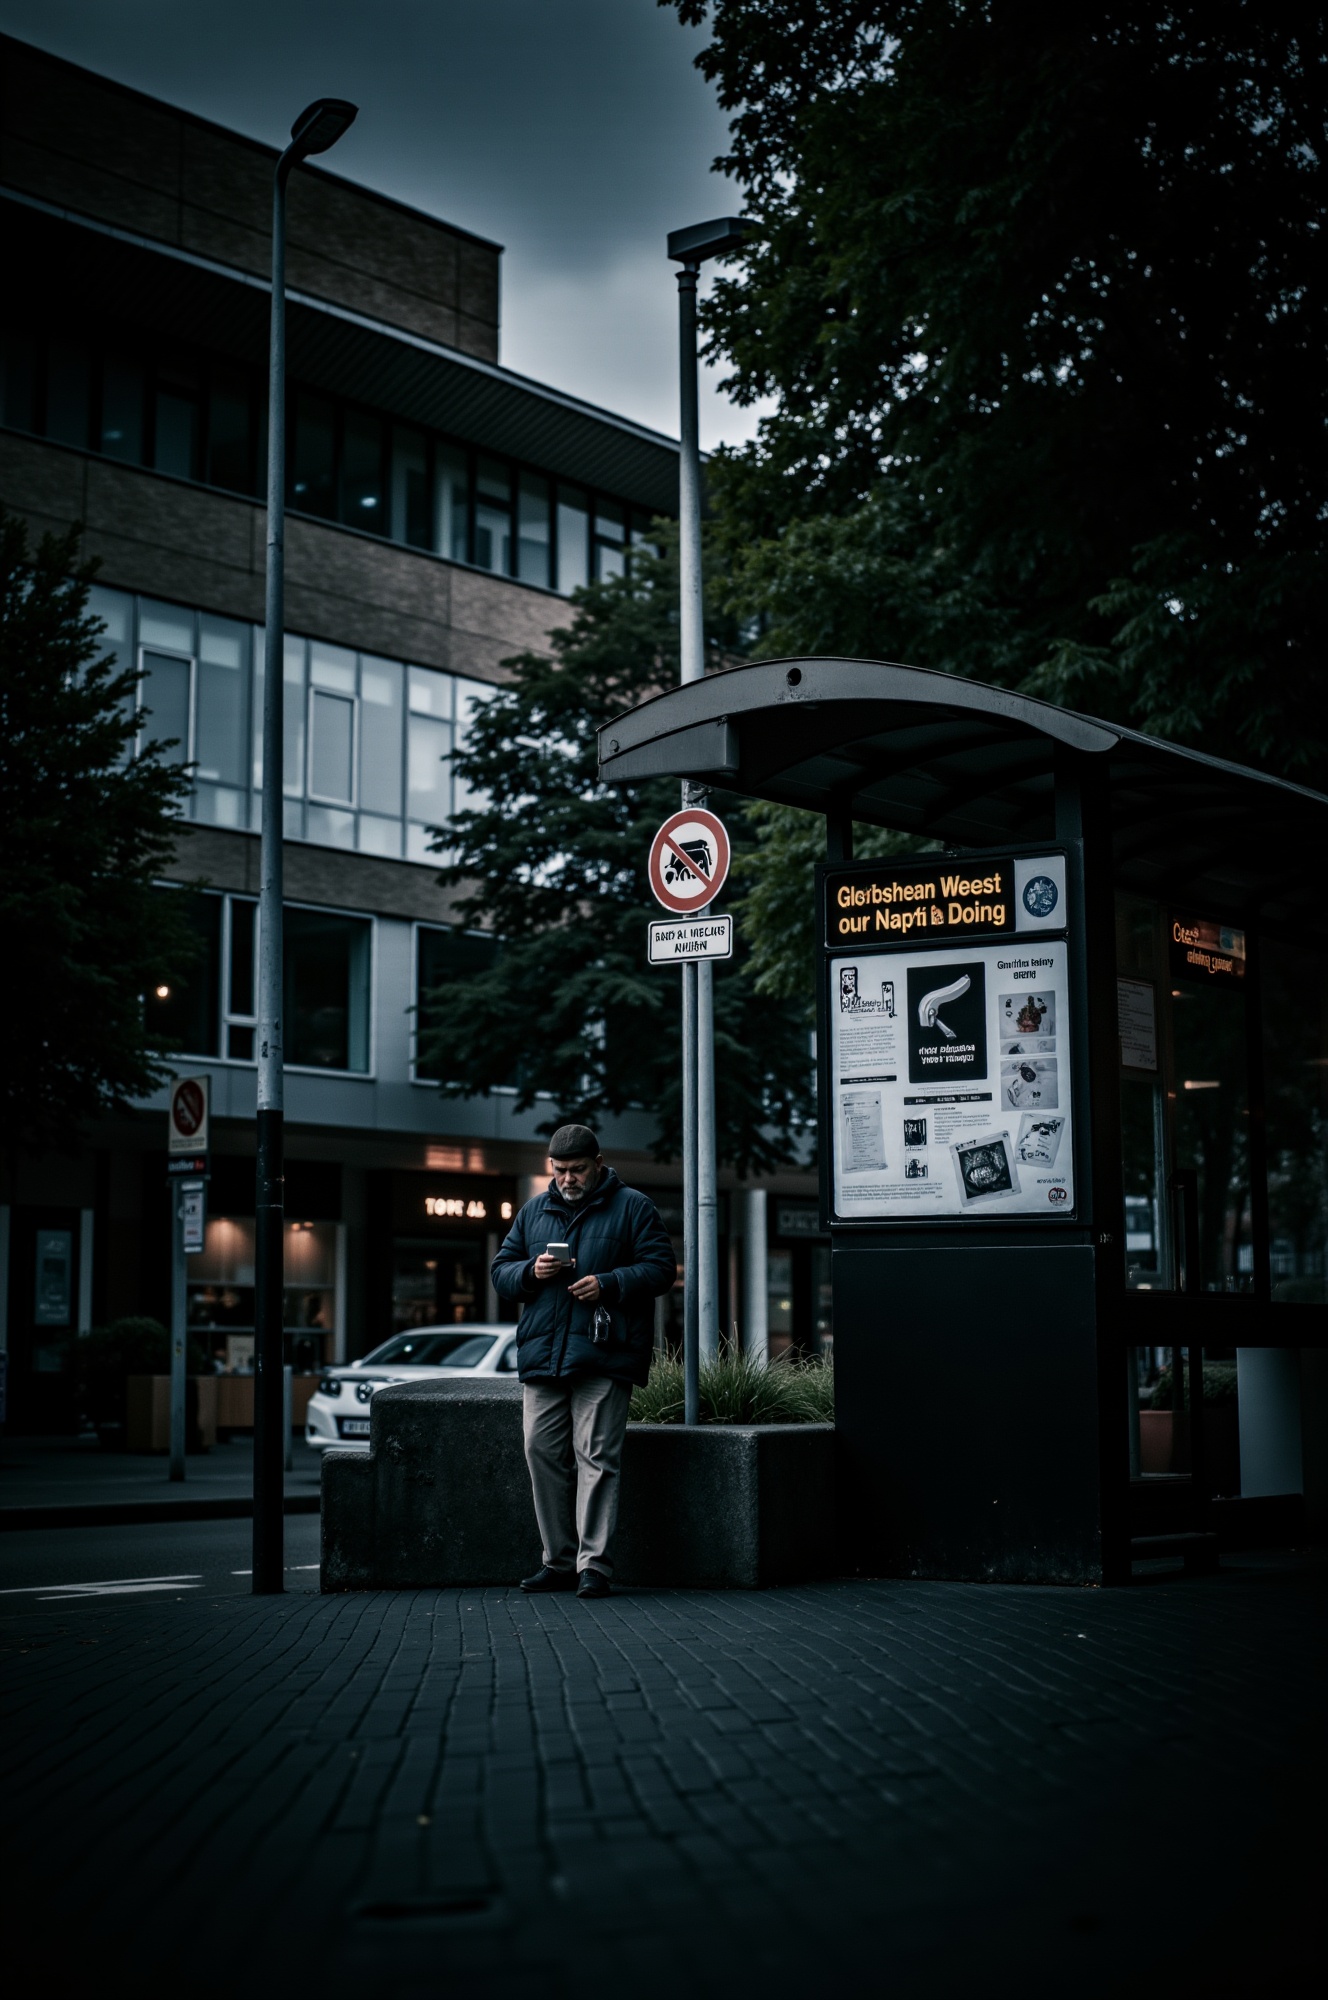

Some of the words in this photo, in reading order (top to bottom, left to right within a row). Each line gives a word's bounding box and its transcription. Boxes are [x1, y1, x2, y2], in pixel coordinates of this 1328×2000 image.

[940, 873, 1002, 898] Weest
[838, 914, 871, 935] our
[948, 901, 1006, 926] Doing
